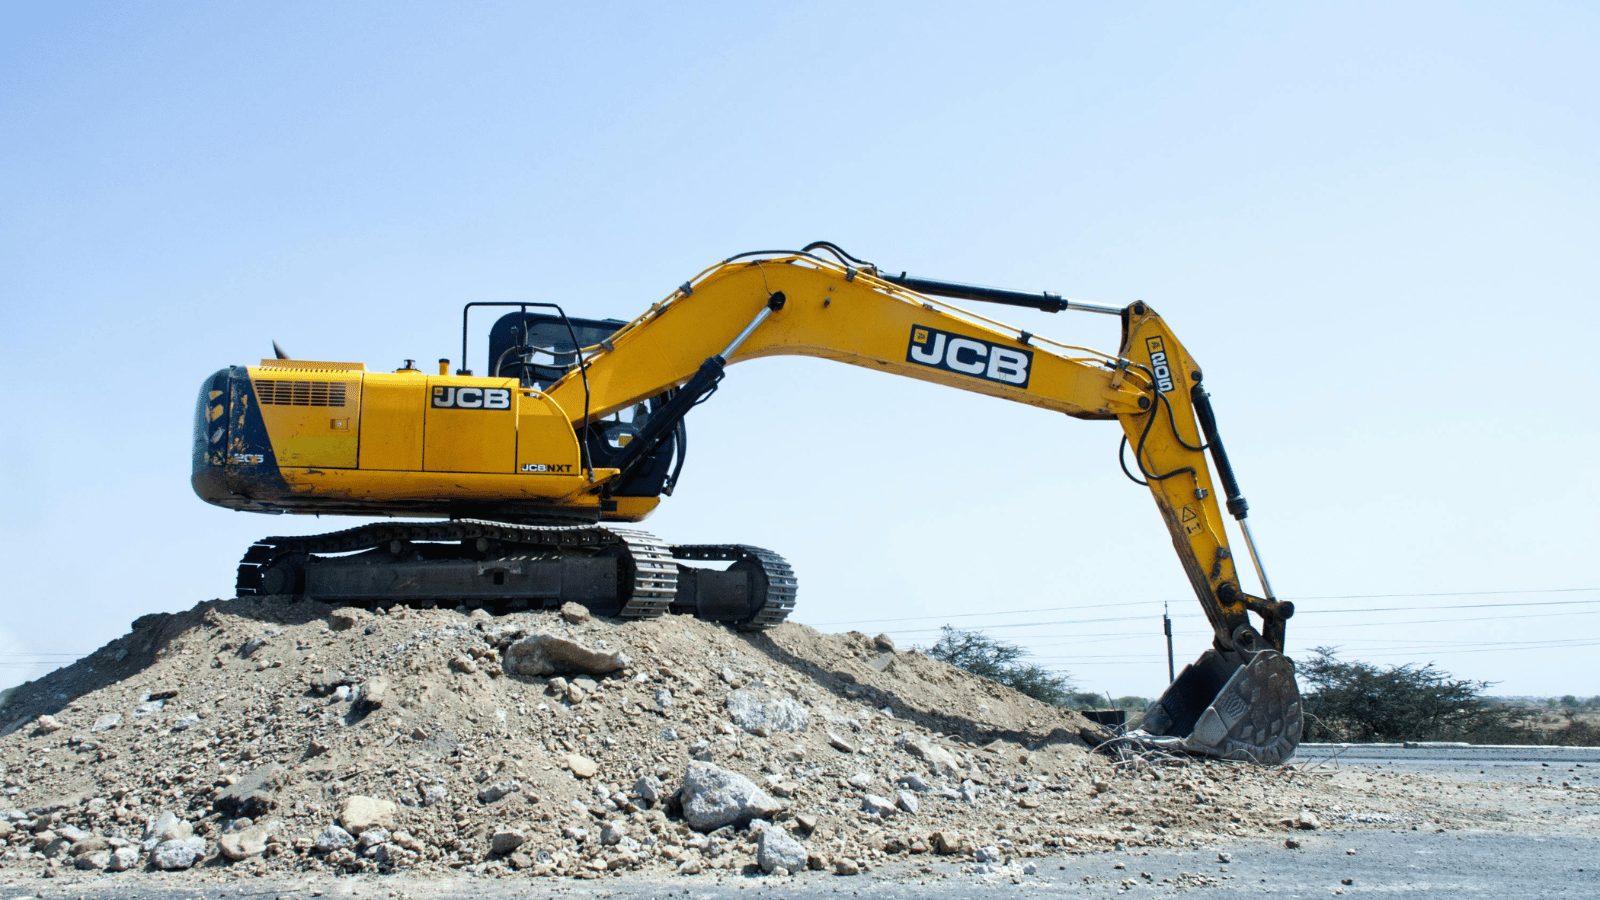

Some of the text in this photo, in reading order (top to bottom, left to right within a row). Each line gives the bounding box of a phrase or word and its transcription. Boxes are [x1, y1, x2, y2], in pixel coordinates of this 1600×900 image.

[911, 333, 1029, 384] JCB
[1151, 352, 1173, 392] 205
[434, 387, 509, 409] JCB
